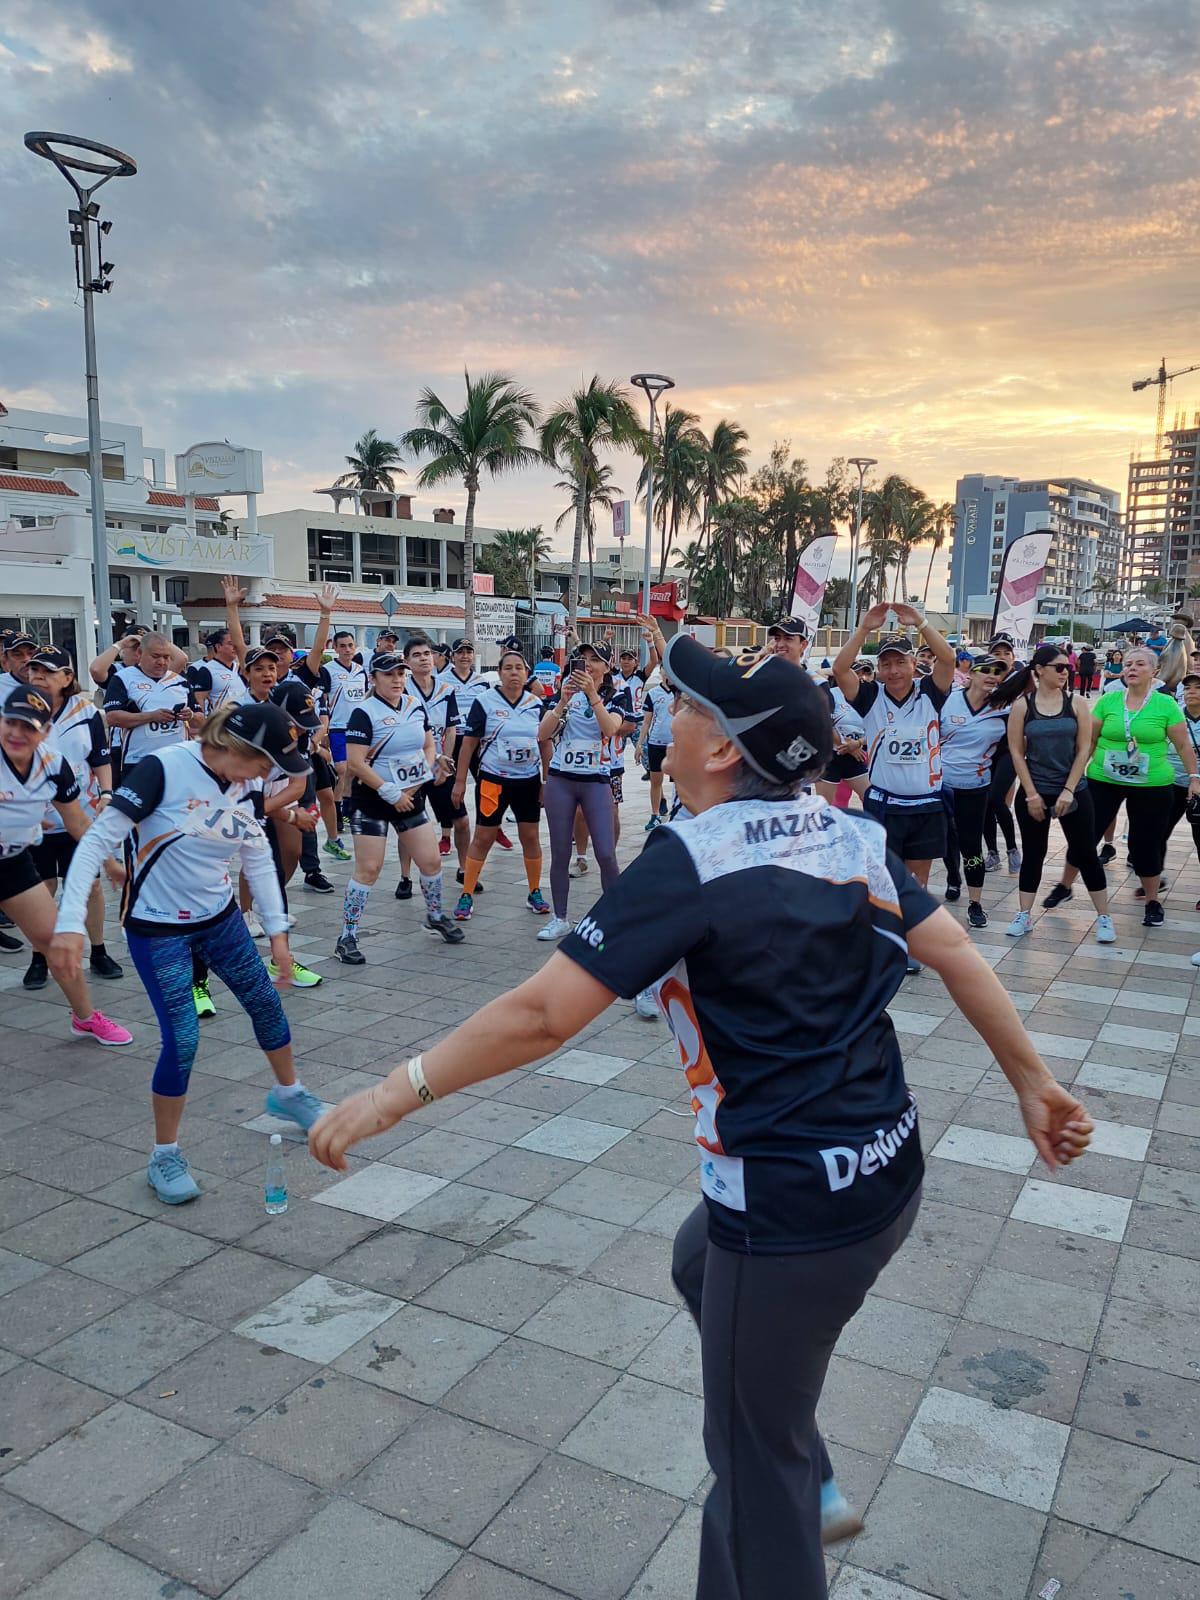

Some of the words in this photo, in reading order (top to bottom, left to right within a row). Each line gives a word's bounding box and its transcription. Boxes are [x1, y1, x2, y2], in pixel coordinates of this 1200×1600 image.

[143, 535, 250, 561] VISTAMAR
[506, 749, 531, 761] 151
[888, 740, 922, 756] 023
[564, 751, 593, 765] 051
[397, 762, 426, 782] 042
[1110, 763, 1140, 776] 182
